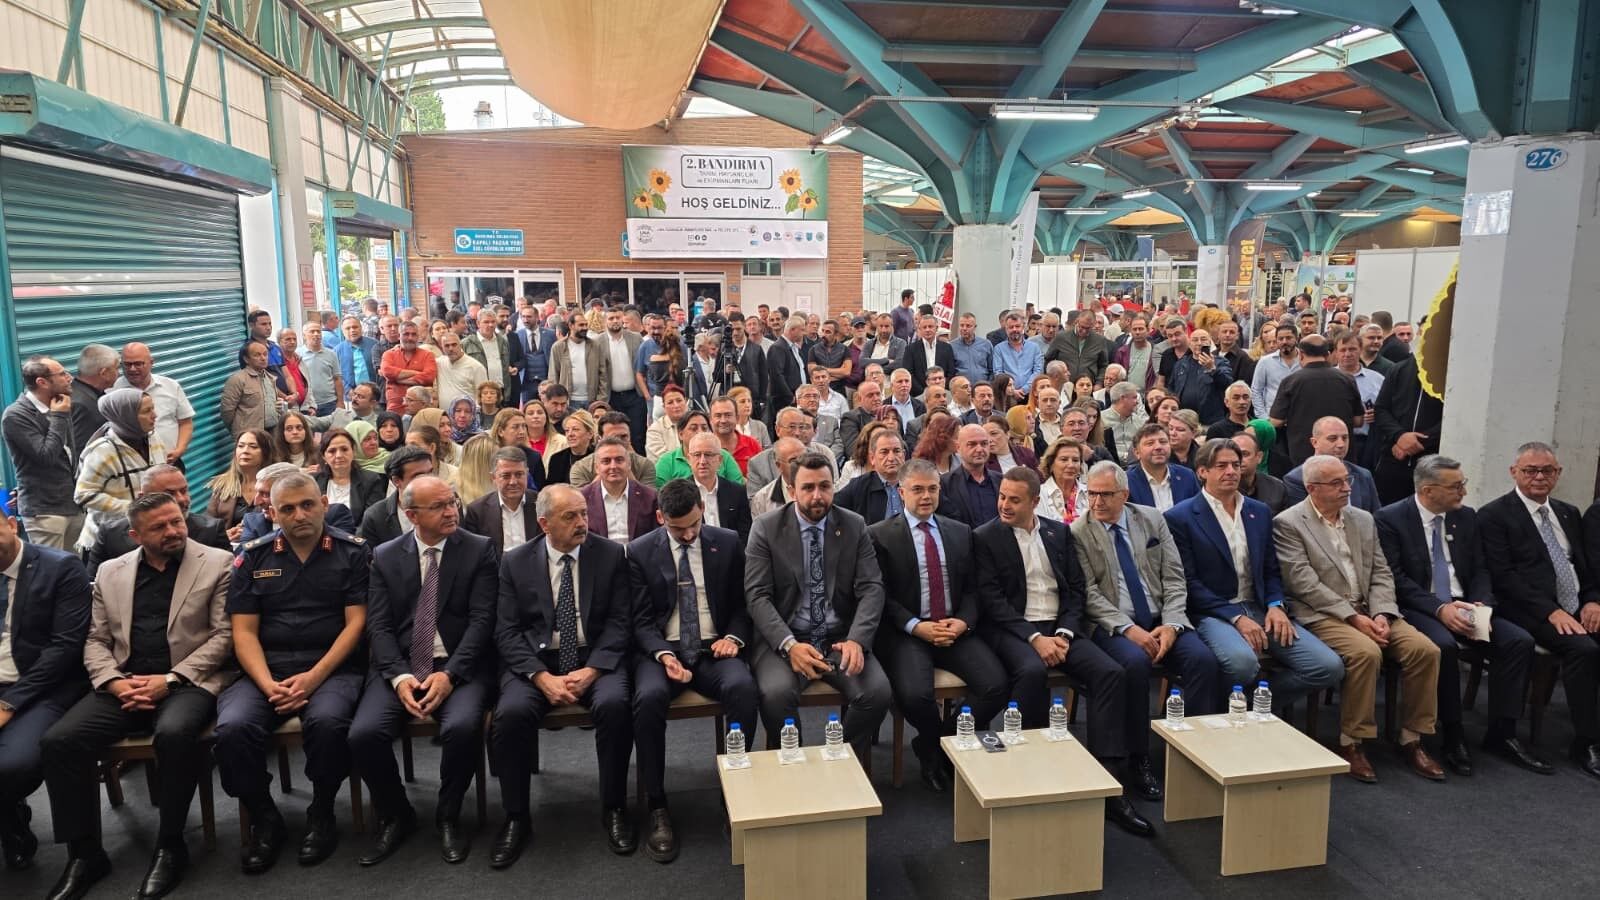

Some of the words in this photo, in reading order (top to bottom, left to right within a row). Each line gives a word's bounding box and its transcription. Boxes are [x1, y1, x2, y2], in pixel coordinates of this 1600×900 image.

[1527, 151, 1562, 166] 276
[681, 197, 709, 210] HOŞ
[712, 196, 781, 209] GELDİNİZ...
